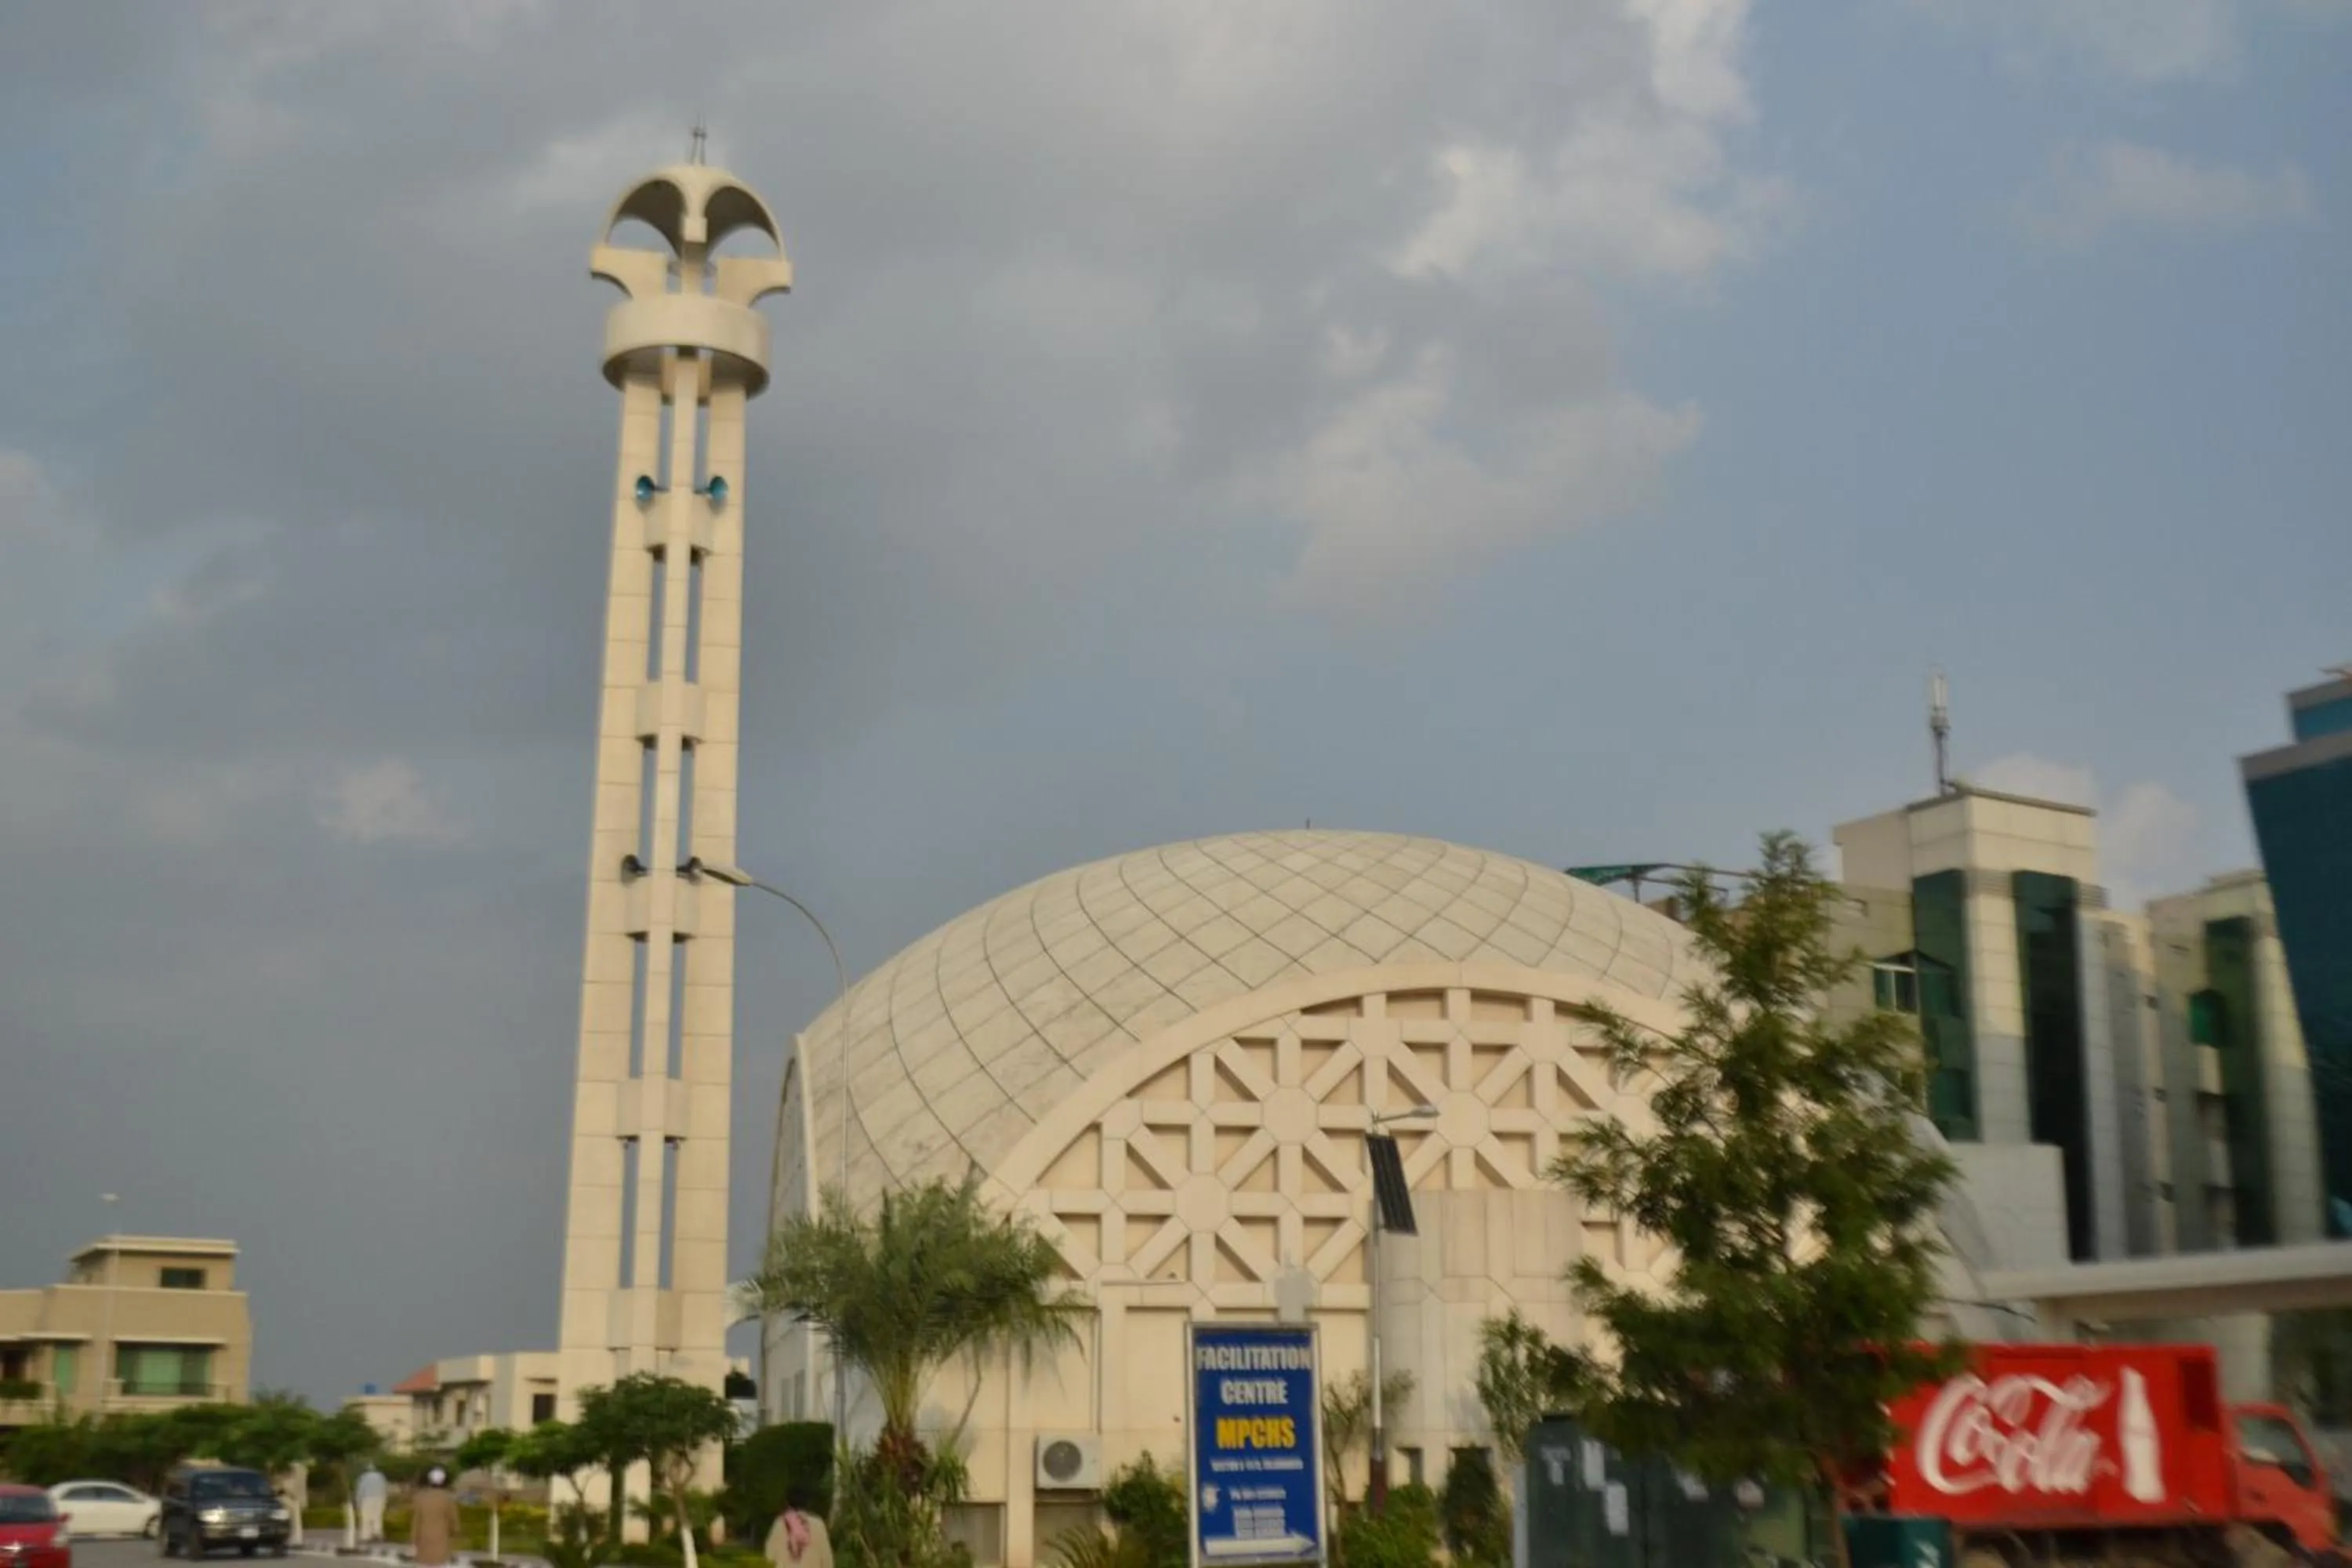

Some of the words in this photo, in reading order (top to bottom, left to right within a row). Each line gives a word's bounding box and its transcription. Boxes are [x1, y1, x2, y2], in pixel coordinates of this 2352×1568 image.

[1196, 1345, 1312, 1370] FACILITATION
[1220, 1379, 1289, 1405] CENTRE
[1217, 1417, 1296, 1449] MPCHS
